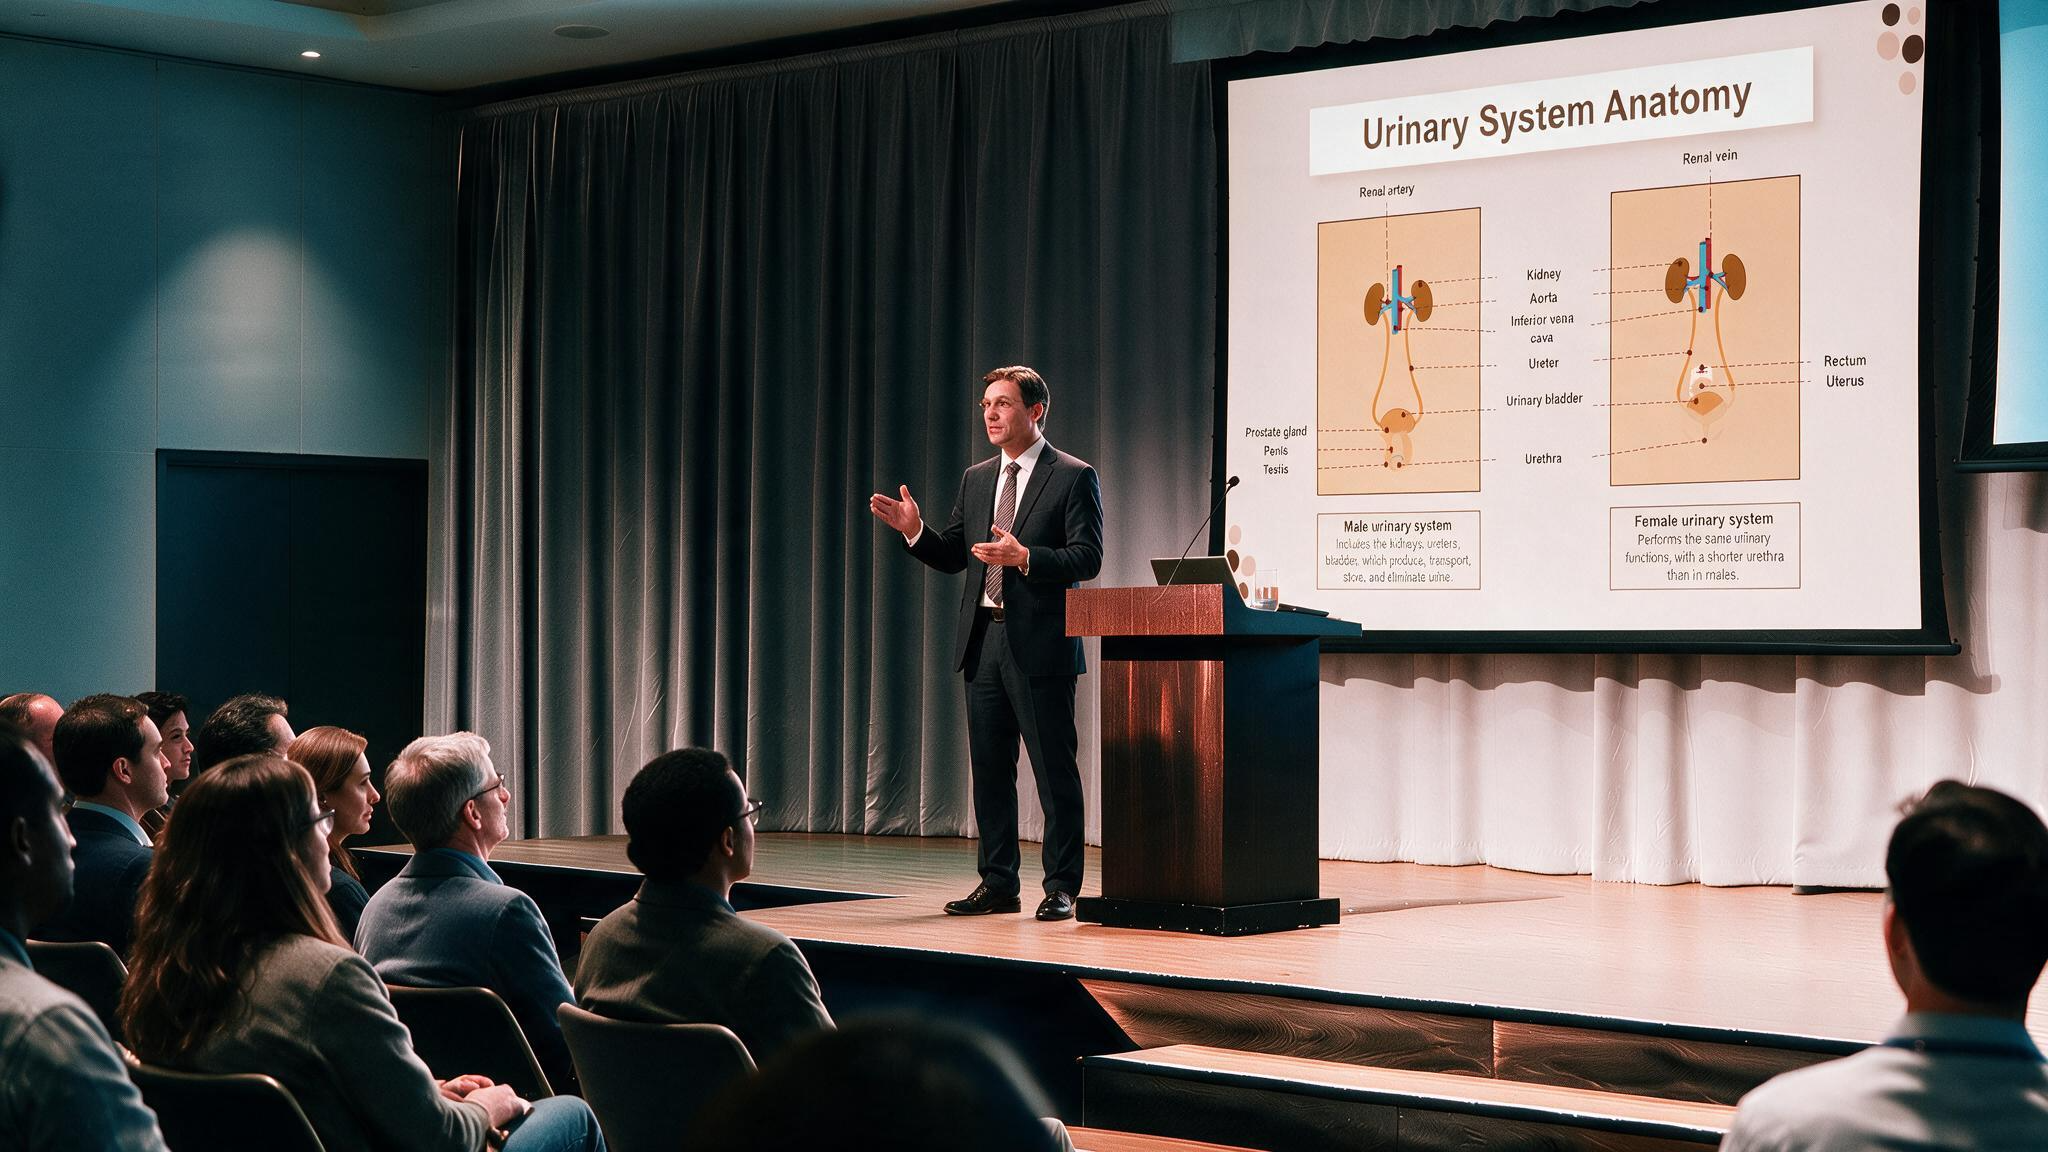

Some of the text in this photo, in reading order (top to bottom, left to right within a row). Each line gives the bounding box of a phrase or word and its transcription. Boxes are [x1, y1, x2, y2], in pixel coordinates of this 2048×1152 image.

[1363, 81, 1752, 150] Urinary System Anatomy
[1683, 149, 1738, 165] Renal vein
[1388, 184, 1415, 197] artery
[1527, 268, 1561, 282] Kidney
[1530, 292, 1557, 304] Aorta
[1511, 314, 1574, 326] Inferior vena
[1530, 334, 1553, 343] cava
[1529, 358, 1559, 369] Ureter
[1824, 355, 1866, 367] Rectum
[1826, 375, 1864, 387] Uterus
[1506, 392, 1583, 408] Urinary bladder
[1245, 425, 1307, 439] Prostate gland
[1264, 446, 1288, 456] Penis
[1525, 453, 1562, 464] Urethra
[1263, 464, 1288, 474] Testis
[1344, 519, 1451, 534] Male urinary system
[1634, 512, 1774, 529] Female urinary system
[1373, 538, 1387, 549] the
[1638, 533, 1682, 545] Performs
[1685, 532, 1701, 544] the
[1705, 534, 1732, 544] same
[1390, 554, 1426, 568] produce,
[1430, 554, 1471, 568] transport,
[1625, 550, 1784, 564] functions, with a shorter urethra
[1369, 572, 1385, 582] and
[1667, 568, 1739, 581] than in males.
